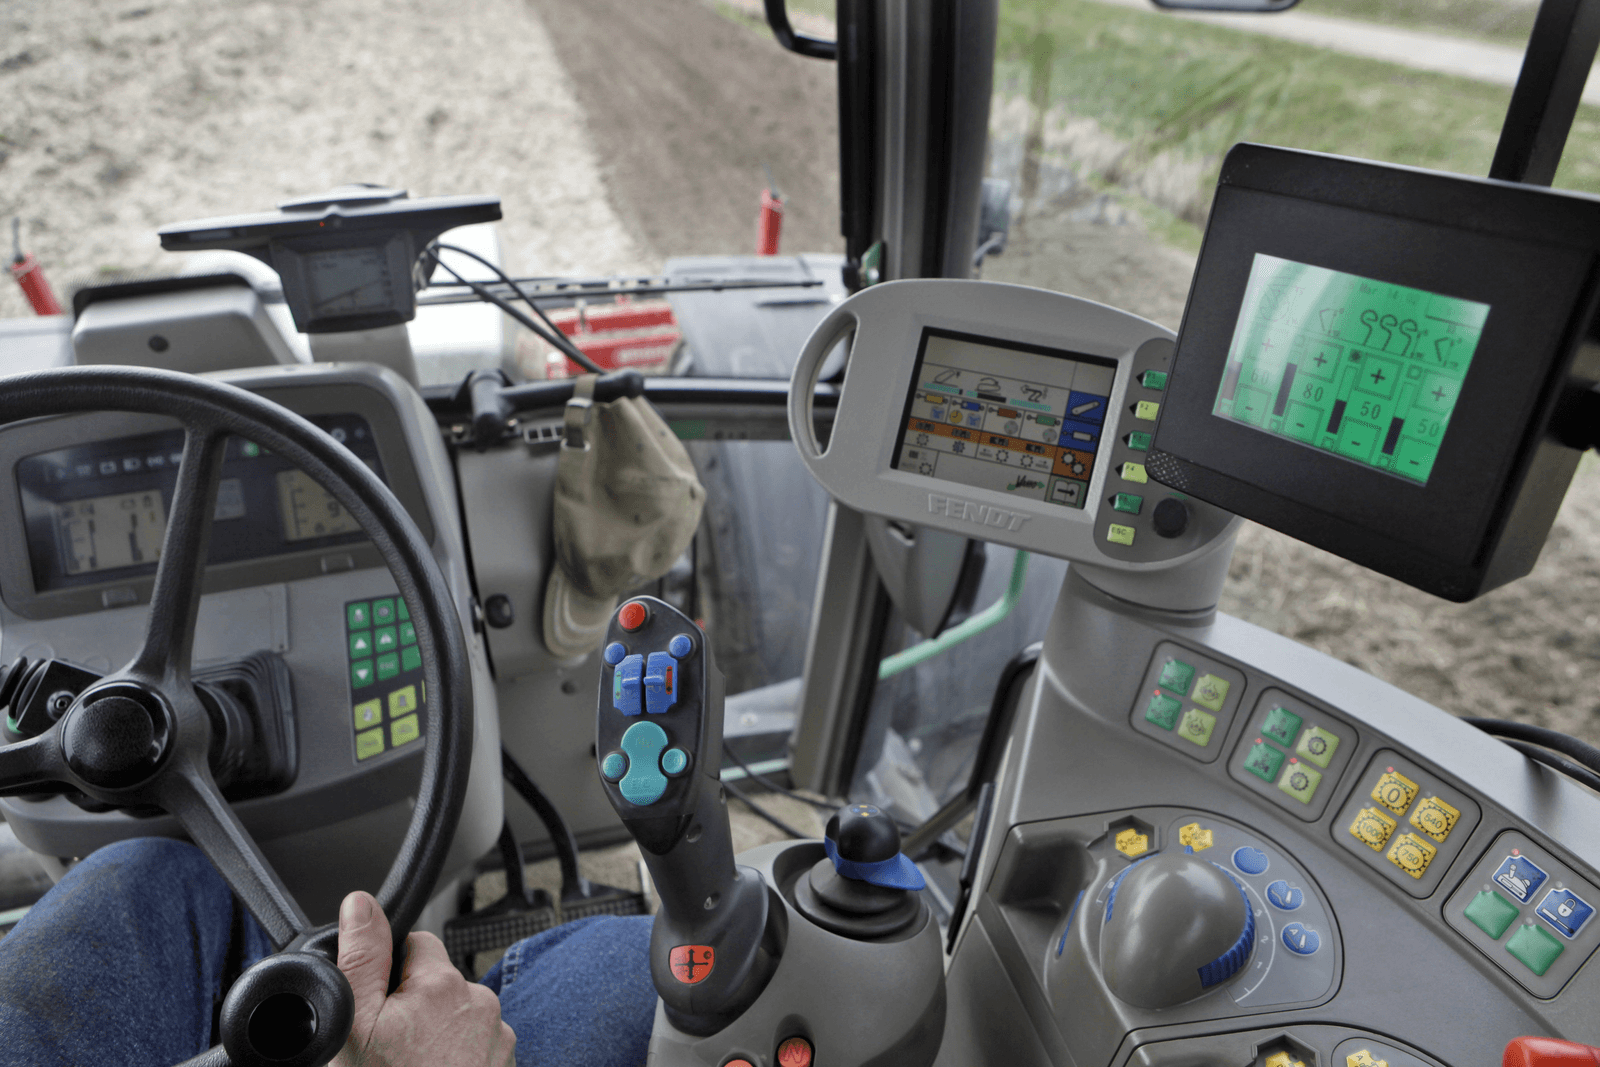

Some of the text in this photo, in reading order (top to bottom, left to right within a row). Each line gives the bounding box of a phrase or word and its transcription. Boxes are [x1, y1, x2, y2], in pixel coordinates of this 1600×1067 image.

[1302, 382, 1324, 403] 80
[1360, 400, 1381, 420] 50
[1417, 418, 1440, 438] 50
[928, 493, 1032, 532] FENDT
[1387, 788, 1401, 803] 0
[1423, 813, 1443, 829] 540
[1401, 848, 1420, 865] 750
[1254, 908, 1263, 918] 3
[1260, 935, 1269, 944] 2
